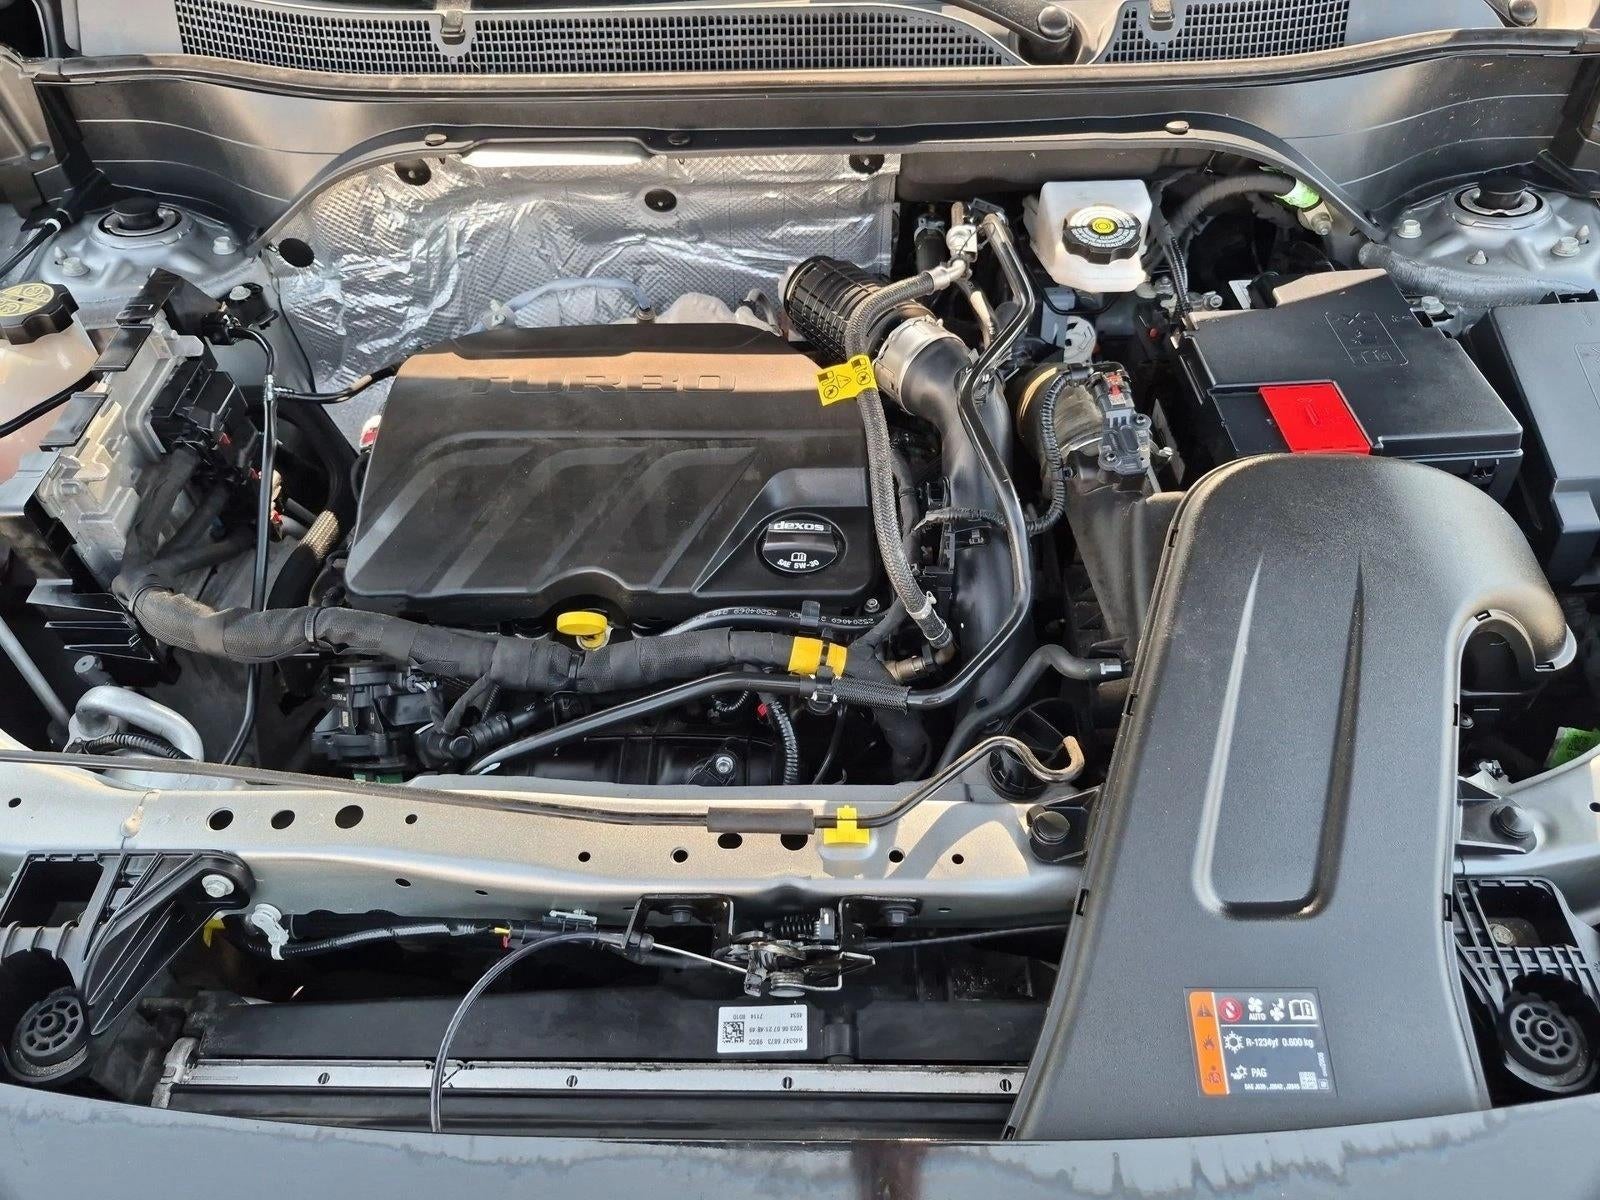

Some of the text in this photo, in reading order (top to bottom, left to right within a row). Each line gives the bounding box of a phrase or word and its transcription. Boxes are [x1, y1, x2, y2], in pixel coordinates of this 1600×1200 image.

[457, 374, 737, 396] TURBO
[773, 520, 825, 531] dexos
[777, 558, 820, 569] SAE 5W-30
[1248, 1011, 1267, 1021] AUTO
[1245, 1037, 1314, 1048] R-1234yf 0.600 kg
[1250, 1067, 1268, 1078] PAG
